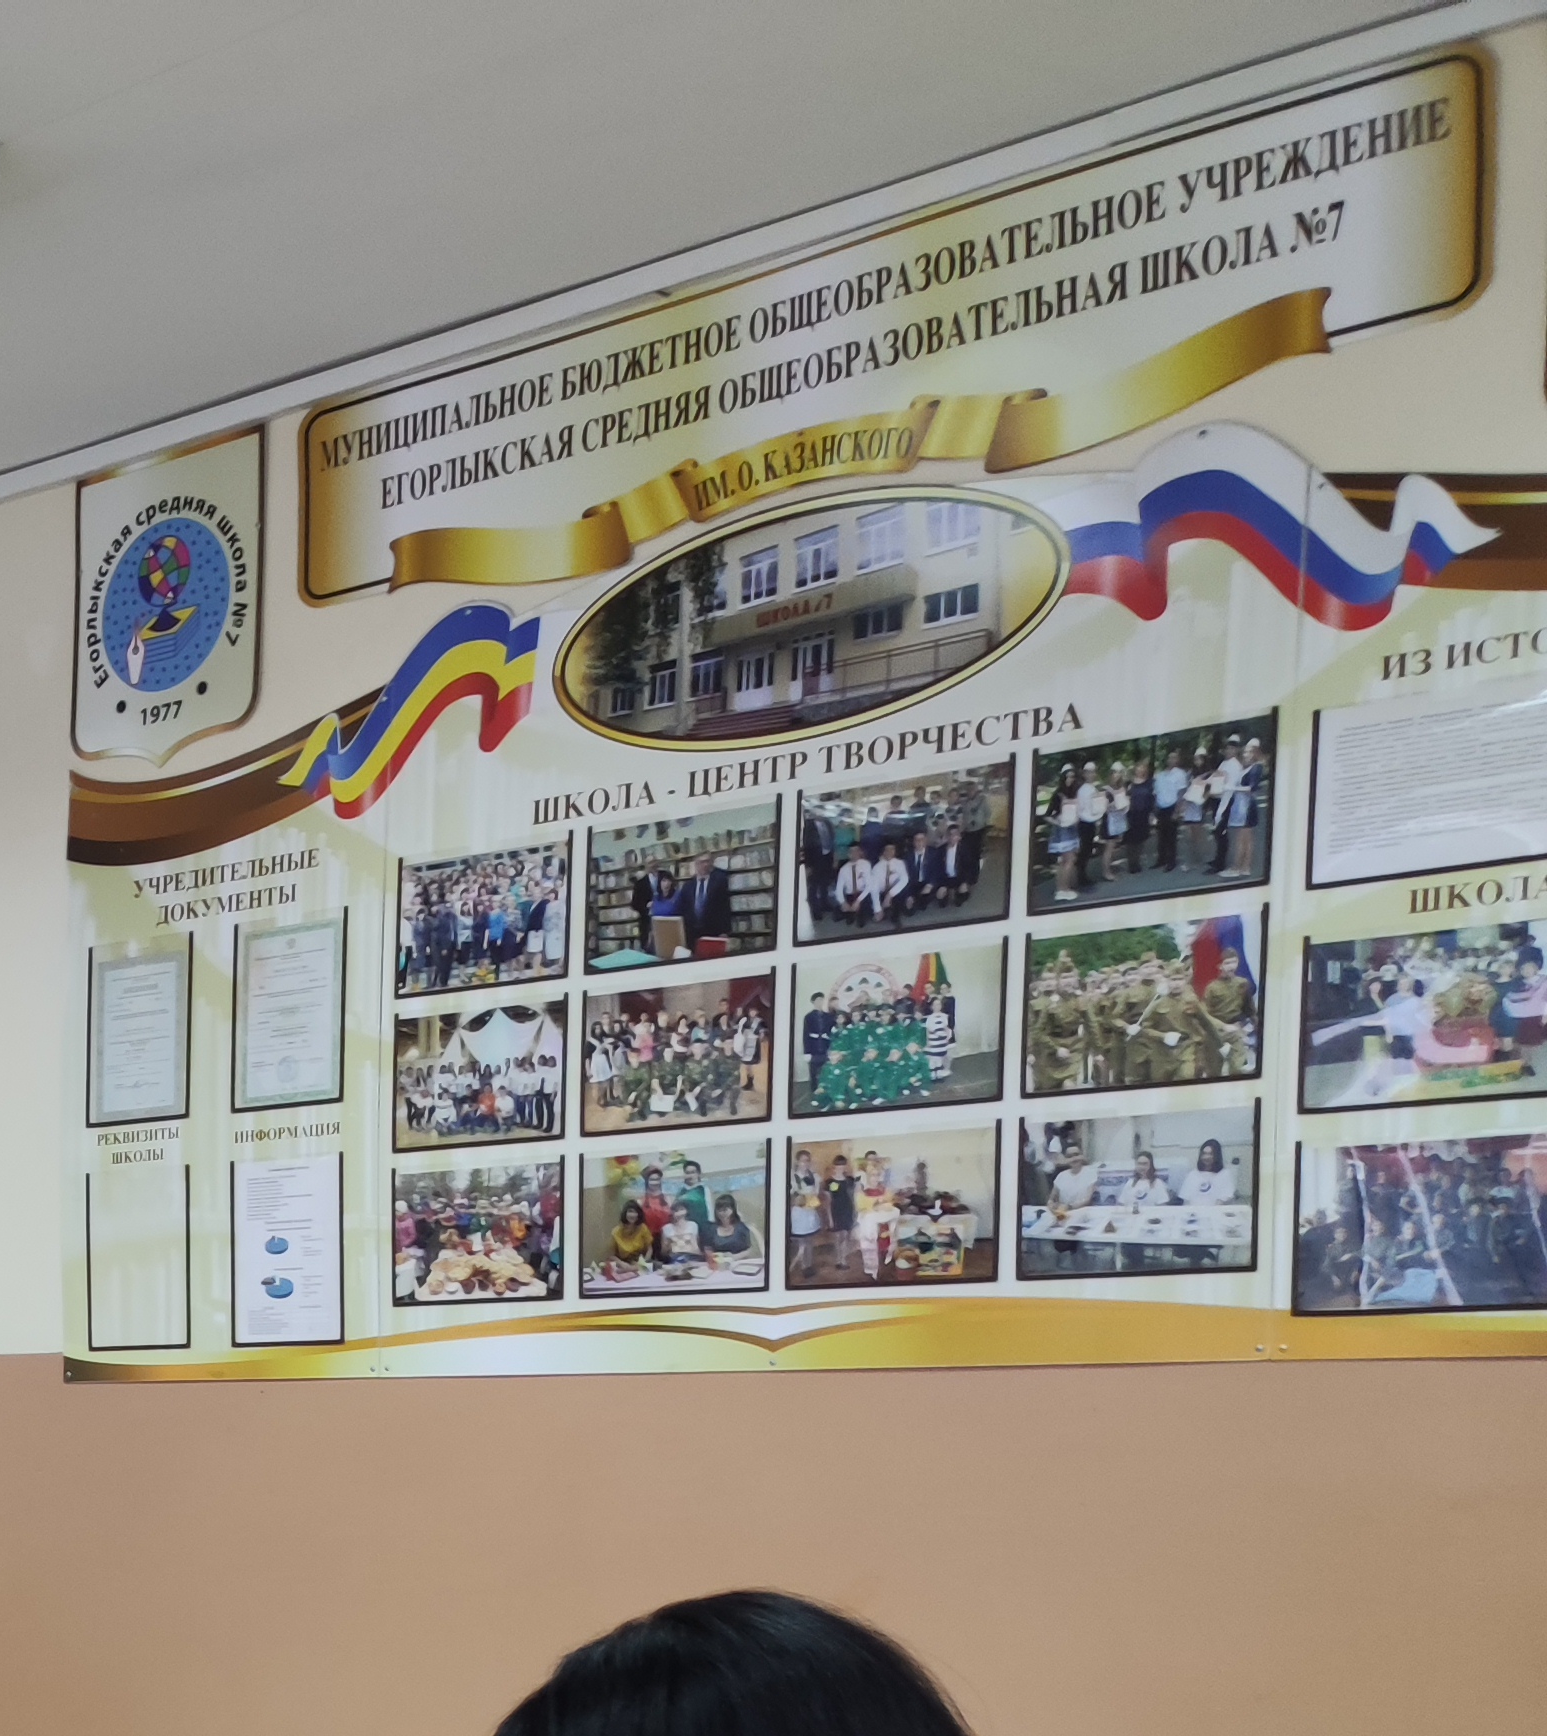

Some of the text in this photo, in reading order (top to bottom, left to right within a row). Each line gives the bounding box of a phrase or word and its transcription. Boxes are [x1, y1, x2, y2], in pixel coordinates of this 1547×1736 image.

[319, 96, 1454, 472] МУНИЦИПАЛЬНОЕ БЮДЖЕТНОЕ ОБЩЕОБРАЗОВАТЕЛЬНОЕ УЧРЕЖДЕНИЕ
[379, 200, 1347, 510] ЕГОРЛЫКСКАЯ СРЕДНЯЯ ОБЩЕОБРАЗОВАТЕЛЬНАЯ ШКОЛА №7
[692, 425, 913, 513] ИМ. О. КАЗАНСКОГО
[134, 495, 218, 527] средняя
[215, 513, 248, 593] школа
[1380, 648, 1433, 682] ИЗ
[139, 699, 183, 726] 1977
[531, 780, 657, 827] ШКОЛА
[686, 752, 809, 799] ЦЕНТР
[818, 701, 1085, 775] ТВОРЧЕСТВА
[132, 847, 320, 899] УЧРЕДИТЕЛЬНЫЕ
[155, 883, 298, 927] ДОКУМЕНТЫ
[96, 1126, 180, 1147] РЕКВИЗИТЫ
[110, 1148, 165, 1165] ШКОЛЫ
[234, 1121, 341, 1145] ИНФОРМАЦИЯ
